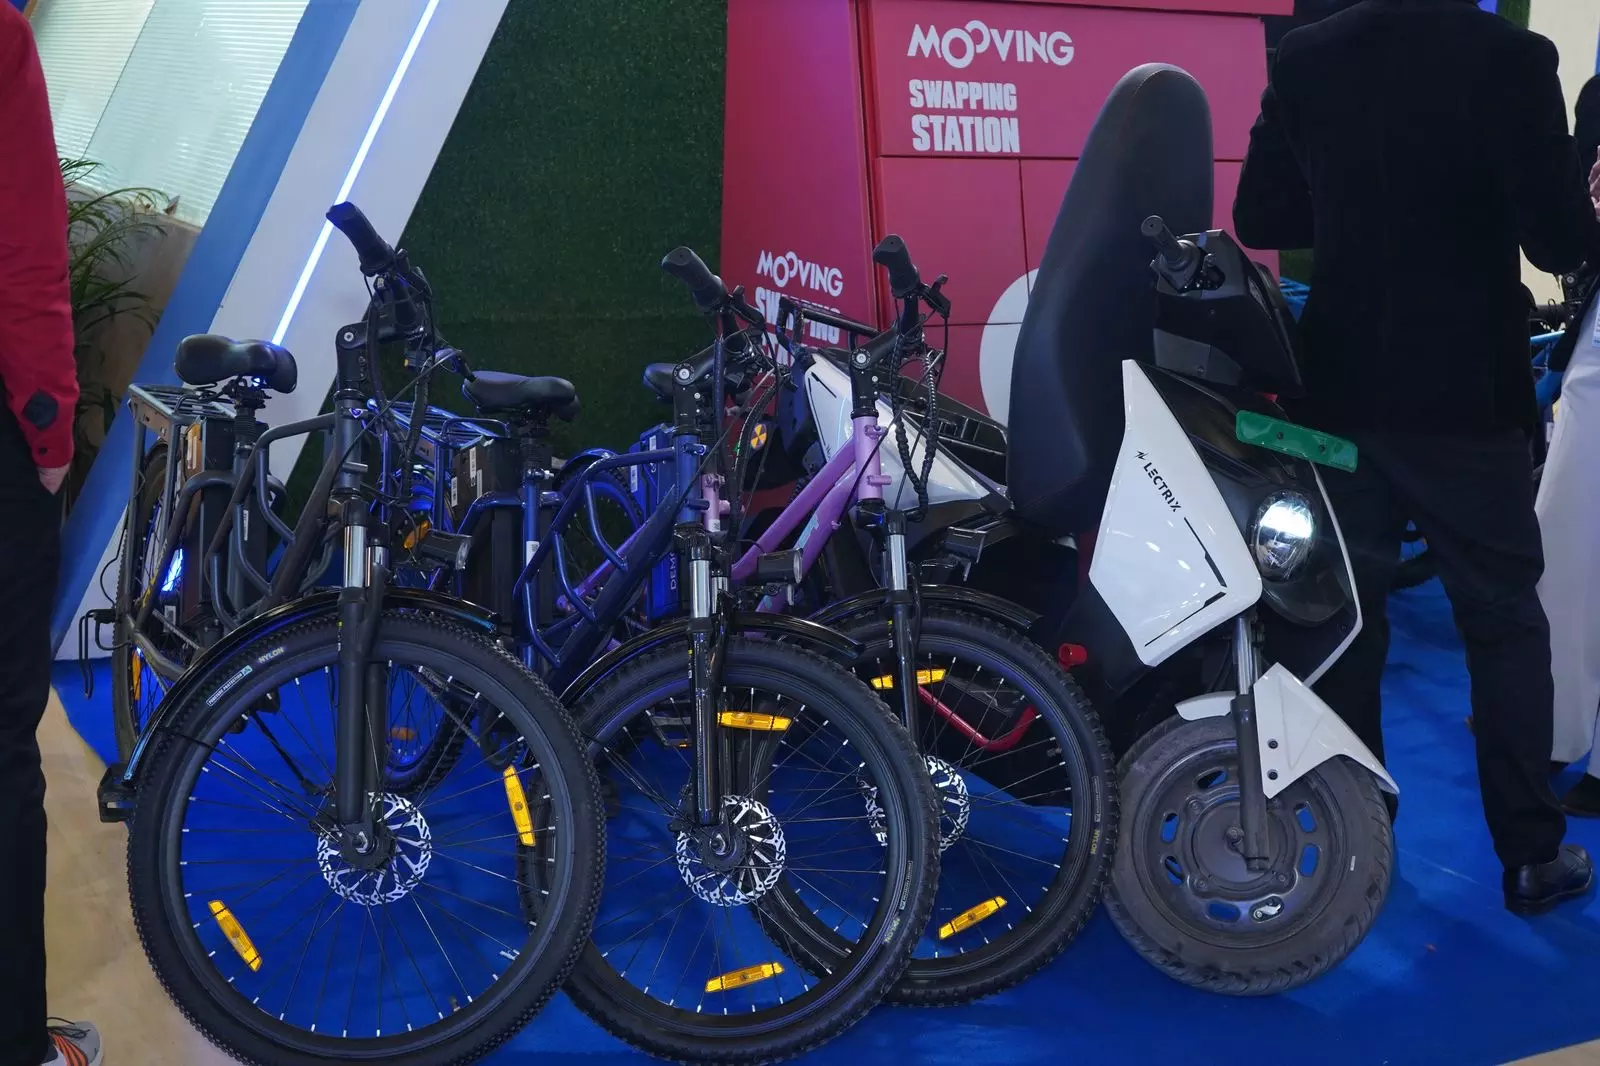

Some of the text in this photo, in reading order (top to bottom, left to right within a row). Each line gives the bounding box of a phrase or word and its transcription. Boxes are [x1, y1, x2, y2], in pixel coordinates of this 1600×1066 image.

[907, 20, 1074, 68] MOOVING
[909, 79, 1017, 111] SWAPPING
[912, 114, 1020, 153] STATION
[756, 250, 843, 297] MOOVING
[1143, 462, 1181, 512] LECTRIX
[258, 647, 284, 664] NYLON
